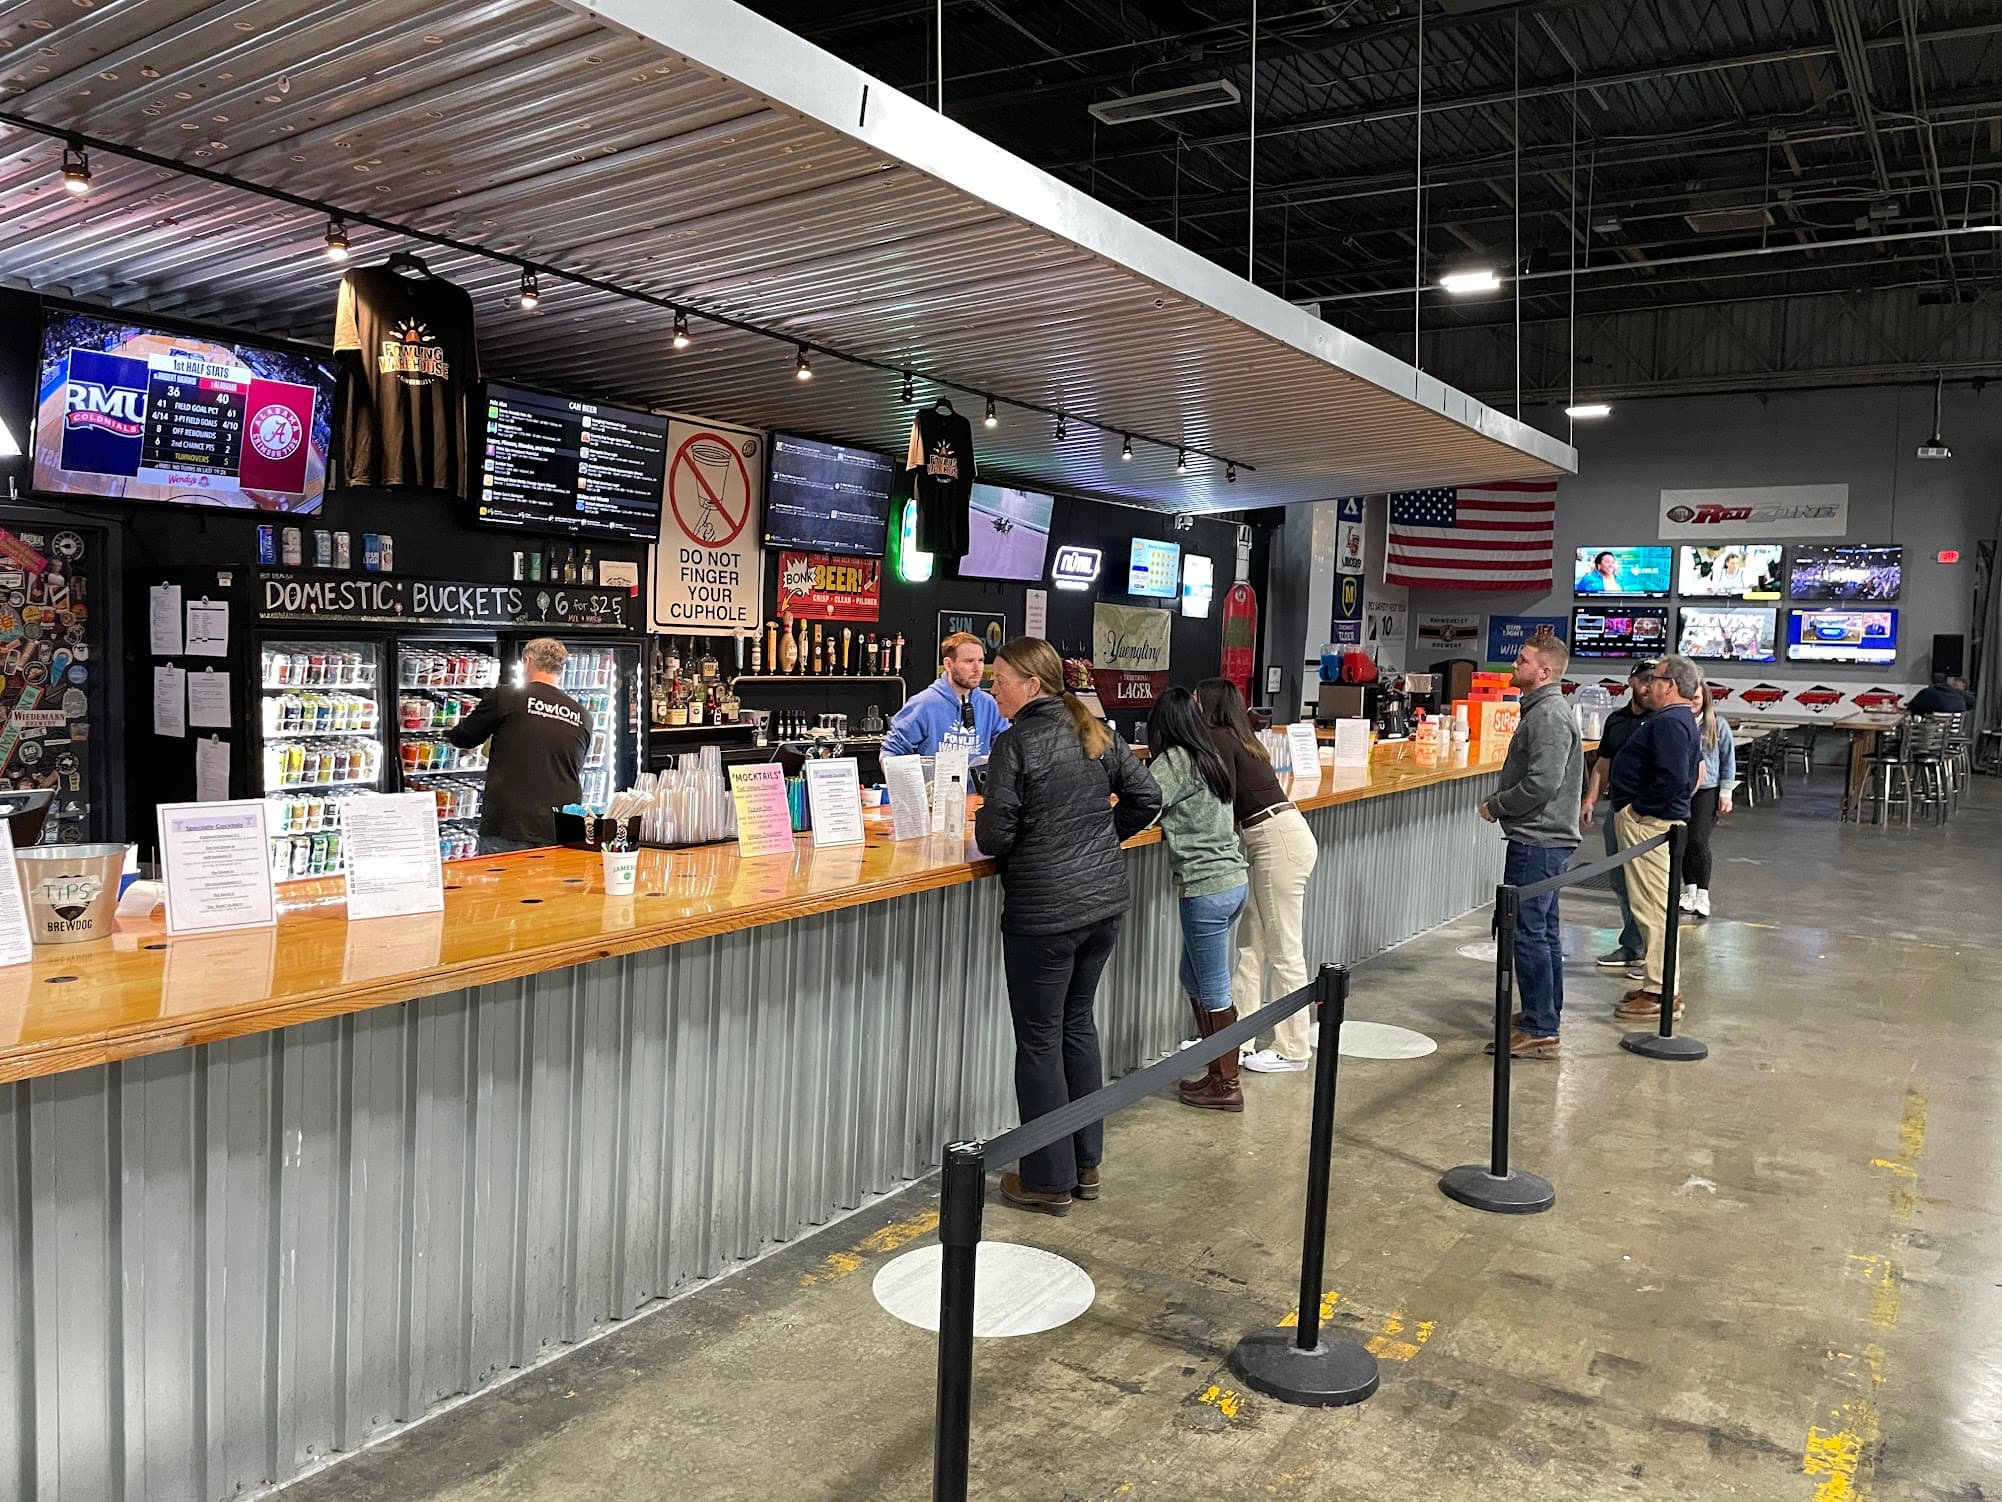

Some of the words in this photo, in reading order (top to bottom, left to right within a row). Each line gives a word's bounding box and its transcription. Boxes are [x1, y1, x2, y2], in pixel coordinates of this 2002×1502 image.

[383, 342, 443, 363] FOWLING
[173, 360, 184, 371] 1st
[186, 362, 205, 374] HALF
[206, 366, 230, 378] STATS
[378, 356, 449, 380] WAREHOUSE
[68, 383, 148, 424] RMU
[167, 386, 180, 397] 36
[216, 393, 230, 404] 40
[156, 399, 167, 408] 41
[174, 402, 191, 412] FIELD
[191, 404, 207, 414] GOAL
[207, 407, 219, 415] PCT
[227, 409, 237, 418] 61
[582, 404, 598, 414] BEER
[73, 413, 137, 433] COLONIALS
[151, 411, 169, 421] 4/14
[185, 416, 200, 425] FIELD
[200, 418, 218, 427] GOALS
[222, 421, 239, 431] 4/10
[156, 424, 162, 433] 8
[172, 427, 184, 435] OFF
[184, 428, 217, 440] REBOUNDS
[226, 433, 232, 442] 3
[154, 437, 160, 445] 6
[171, 439, 182, 448] 2nd
[182, 441, 205, 450] CHANCE
[205, 444, 215, 452] PTS
[225, 445, 231, 454] 2
[174, 452, 210, 464] TURNOVERS
[224, 458, 229, 466] 5
[680, 548, 703, 565] DO
[708, 551, 741, 568] NOT
[681, 566, 739, 585] FINGER
[786, 572, 813, 585] BONK
[815, 564, 863, 593] BEER!
[265, 580, 394, 611] DOMESTIC
[413, 582, 523, 614] BUCKETS
[554, 591, 569, 615] 6
[573, 599, 588, 611] for
[590, 595, 622, 616] $25
[688, 585, 732, 603] YOUR
[812, 594, 829, 603] CRISP
[856, 597, 878, 606] PILSNER
[670, 603, 746, 621] CUPHOLE
[948, 616, 973, 633] SUN
[1382, 615, 1392, 637] 10
[1103, 630, 1162, 665] Yuengling
[1123, 673, 1150, 681] TRADITIONAL
[1117, 682, 1153, 699] LAGER
[14, 710, 66, 721] WIEDEMANN
[47, 919, 93, 932] BREWDOG
